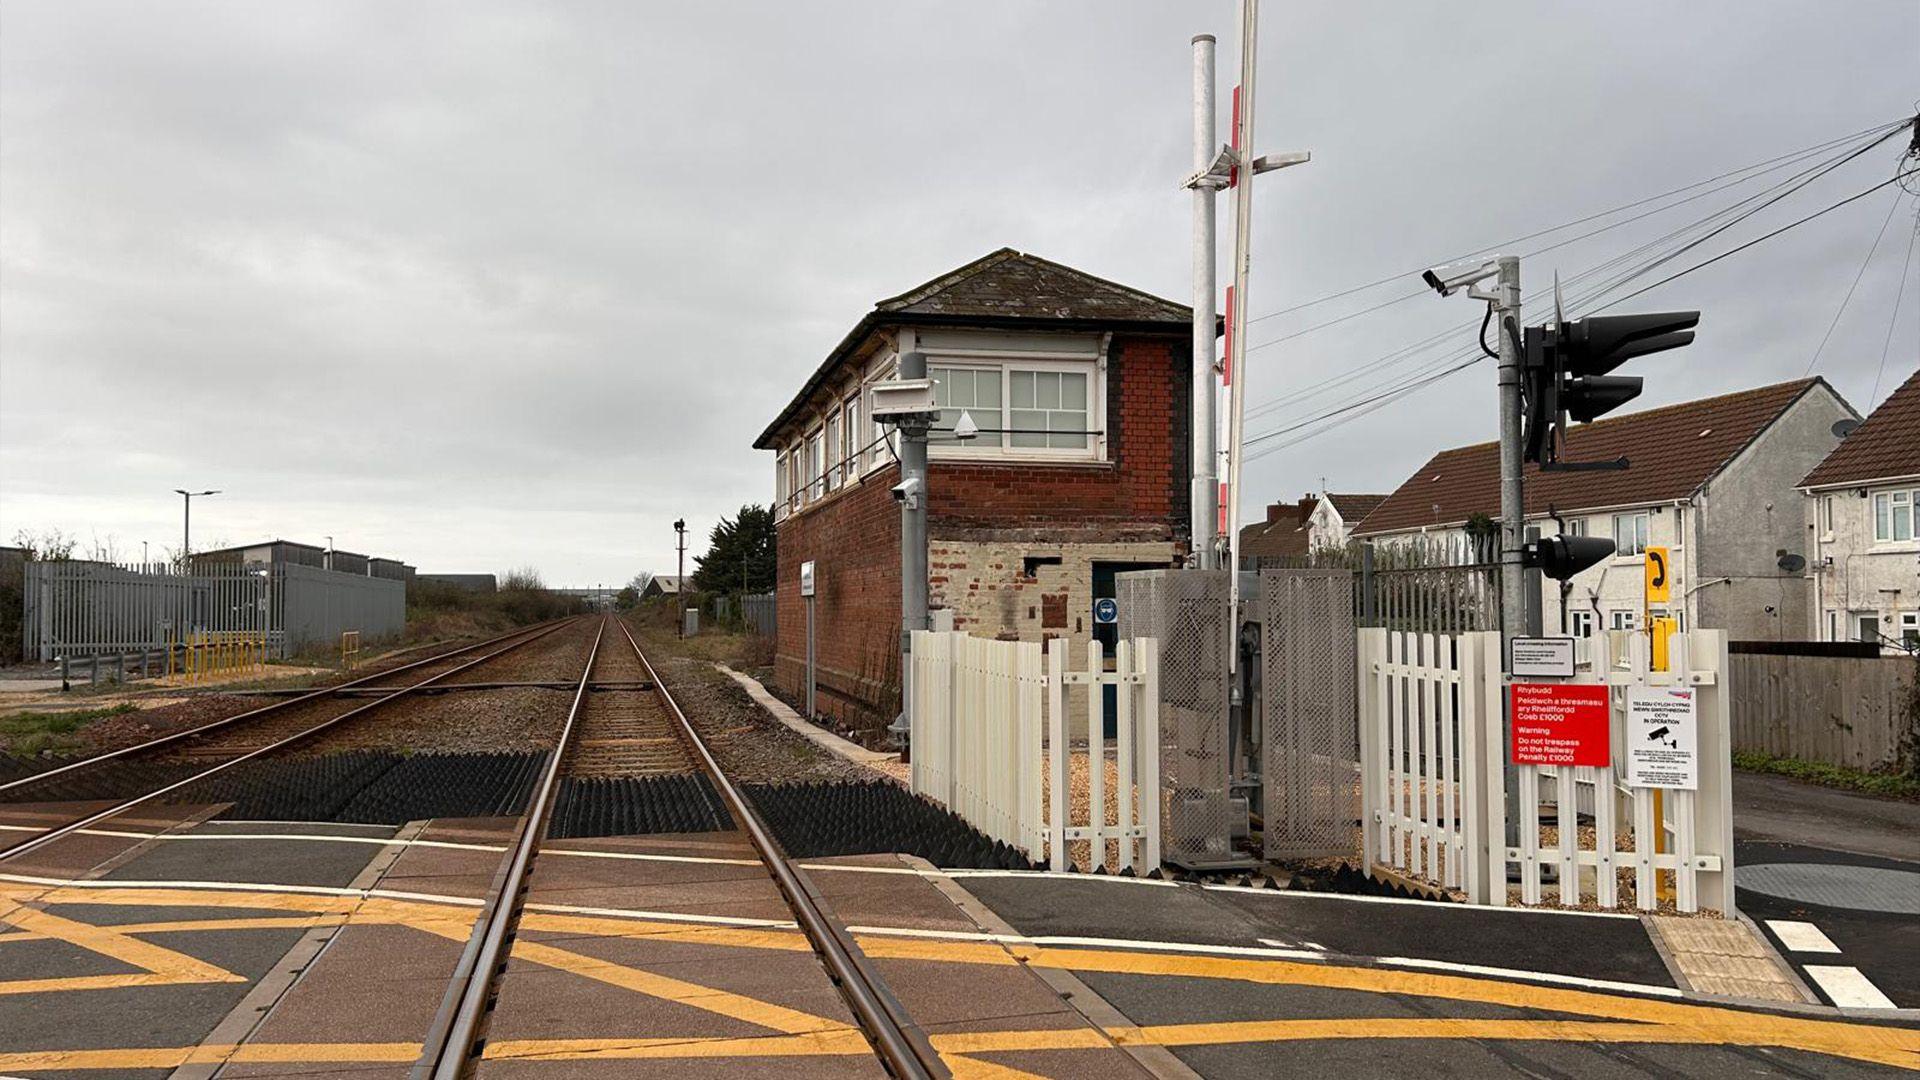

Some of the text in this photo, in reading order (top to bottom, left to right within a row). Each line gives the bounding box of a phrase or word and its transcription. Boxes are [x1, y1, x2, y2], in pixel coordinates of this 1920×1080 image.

[1517, 686, 1552, 695] Rhybudd
[1517, 697, 1553, 705] Peidiwch
[1539, 713, 1565, 721] £1000
[1517, 727, 1550, 735] Warning
[1544, 738, 1580, 746] trespass
[1543, 746, 1575, 755] Railway
[1518, 753, 1574, 762] Penalty £1000
